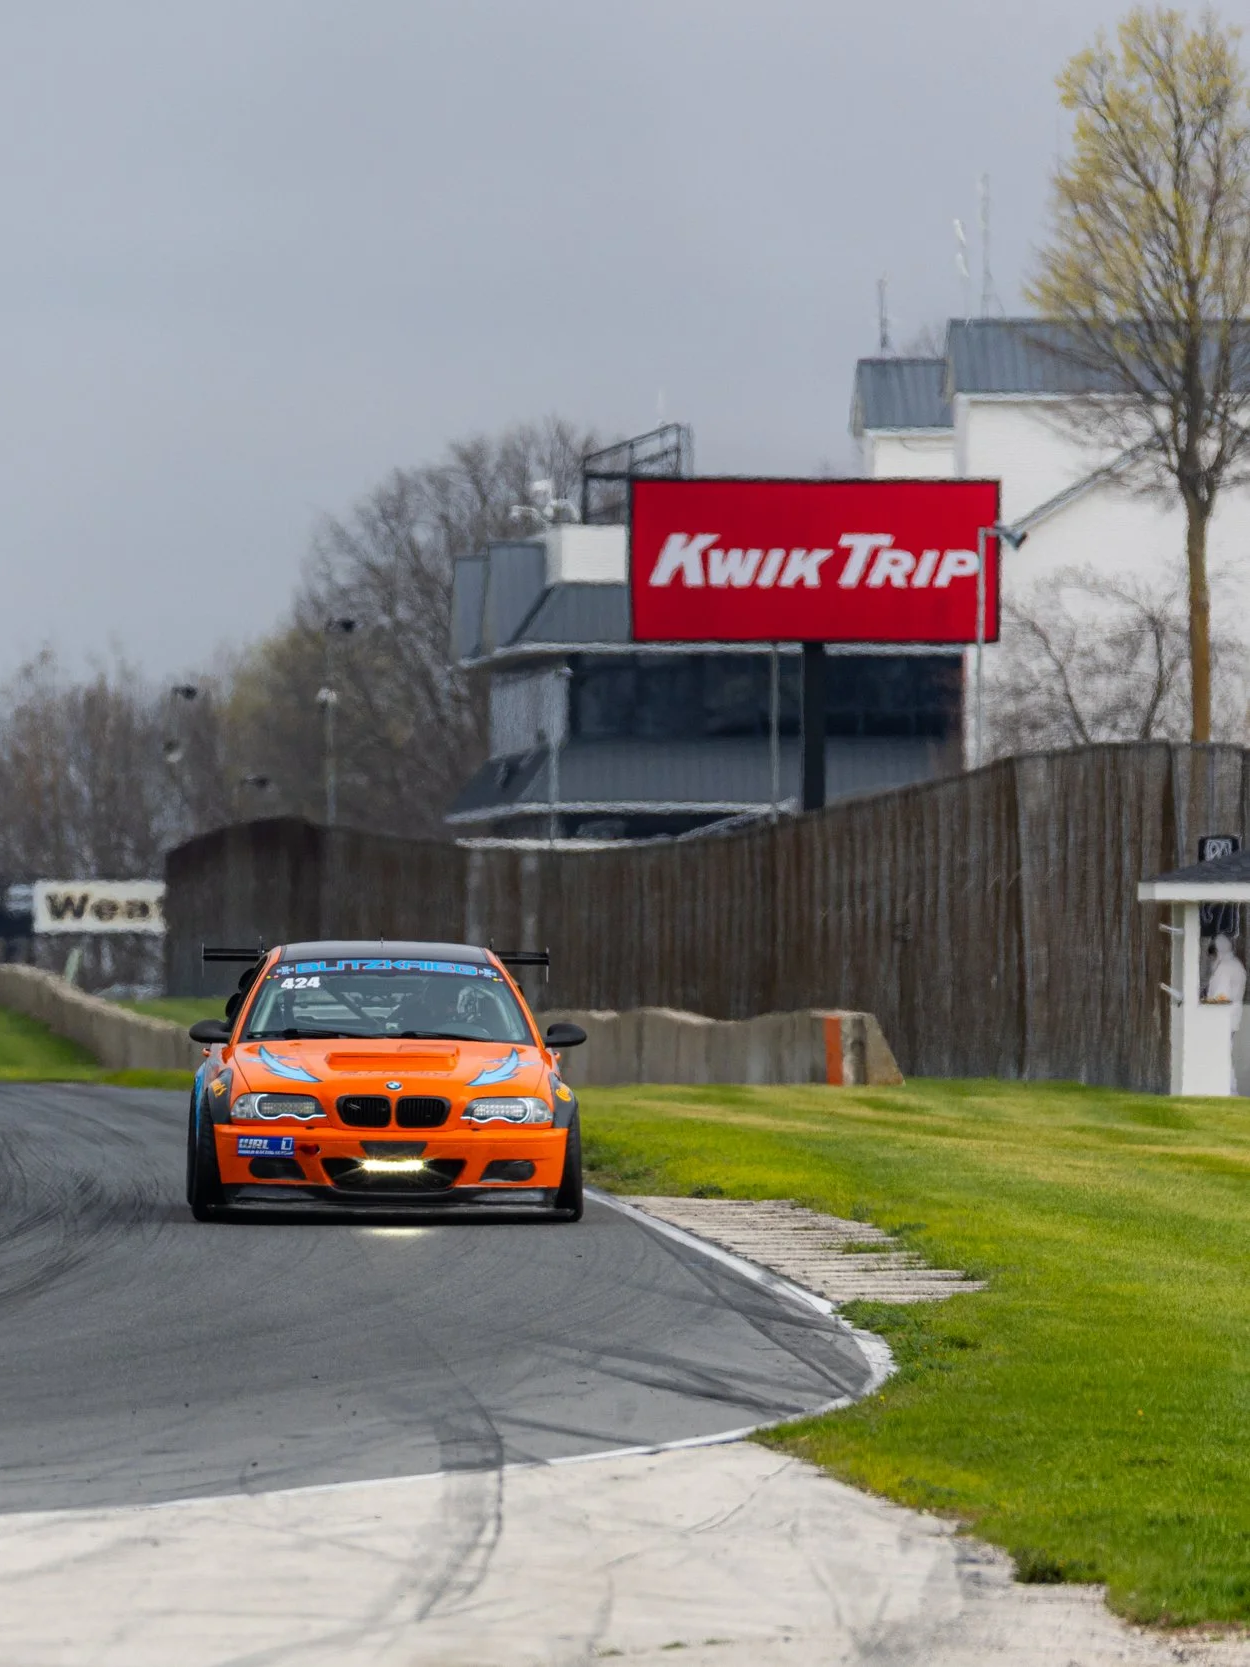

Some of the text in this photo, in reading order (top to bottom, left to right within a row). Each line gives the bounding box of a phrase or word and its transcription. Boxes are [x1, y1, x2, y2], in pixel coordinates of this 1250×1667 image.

[649, 532, 979, 588] KWIK TRIP
[295, 959, 478, 976] BLITZKRIEG
[280, 976, 321, 991] 424
